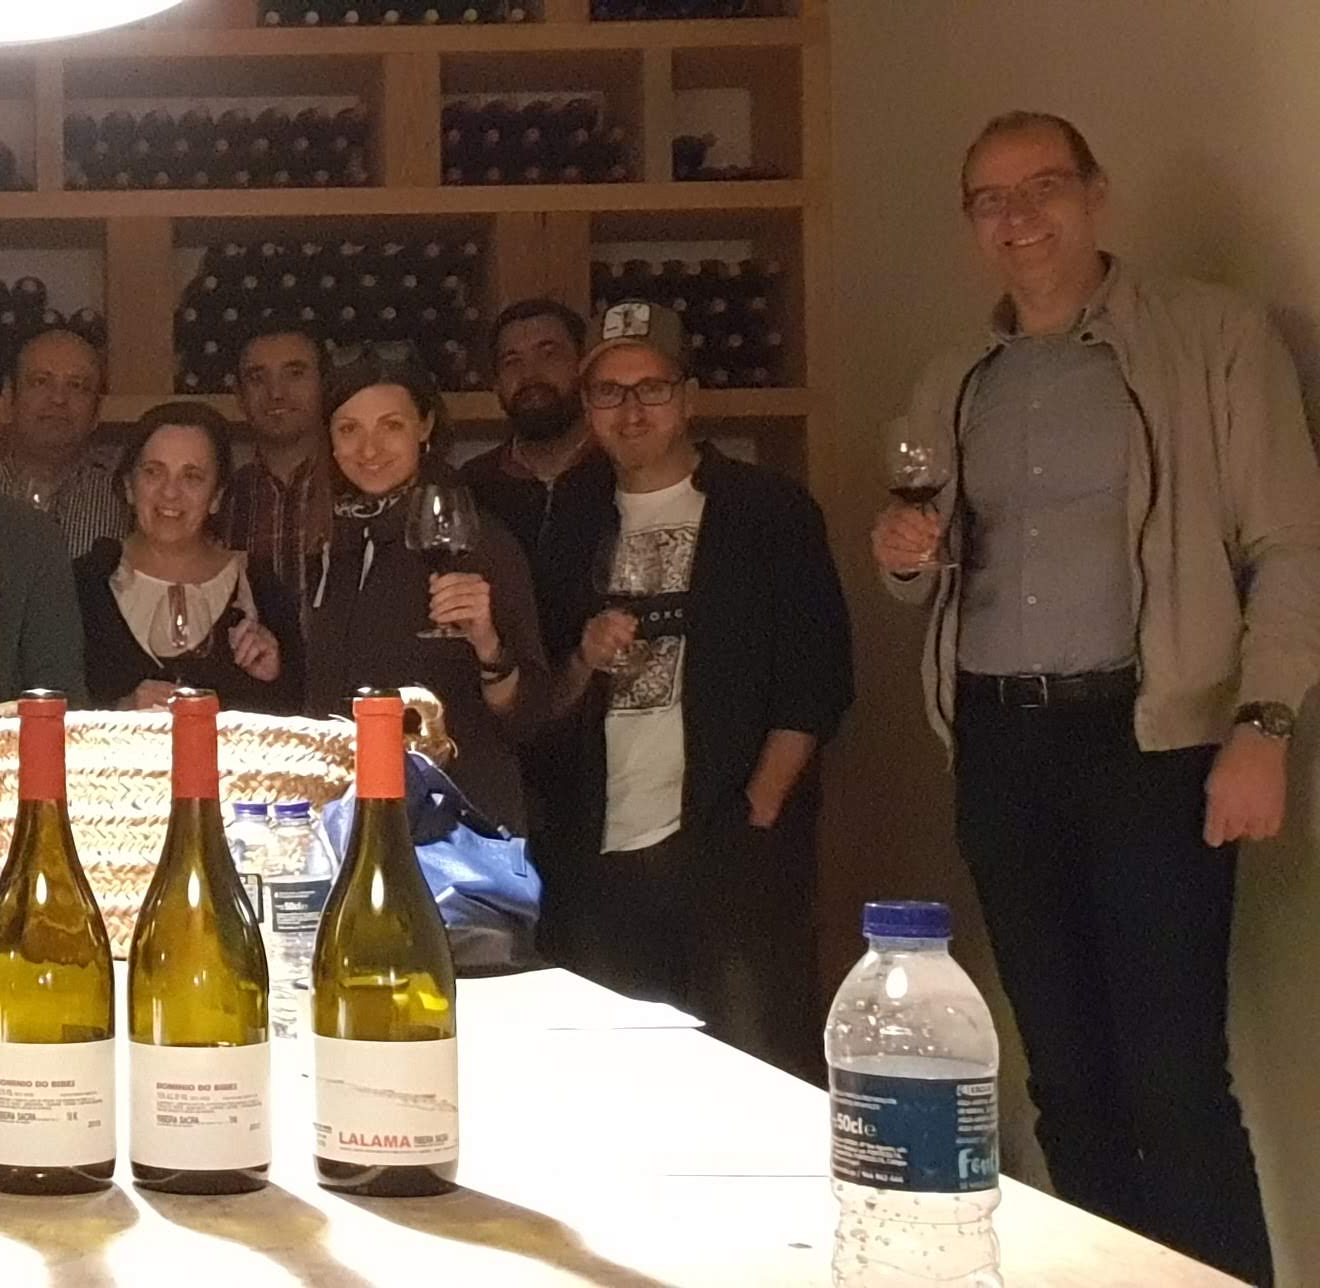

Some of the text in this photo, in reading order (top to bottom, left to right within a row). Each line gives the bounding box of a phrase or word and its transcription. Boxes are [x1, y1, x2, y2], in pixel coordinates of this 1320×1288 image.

[35, 1080, 49, 1088] DO
[837, 1112, 863, 1136] 50cl
[338, 1131, 412, 1149] LALAMA
